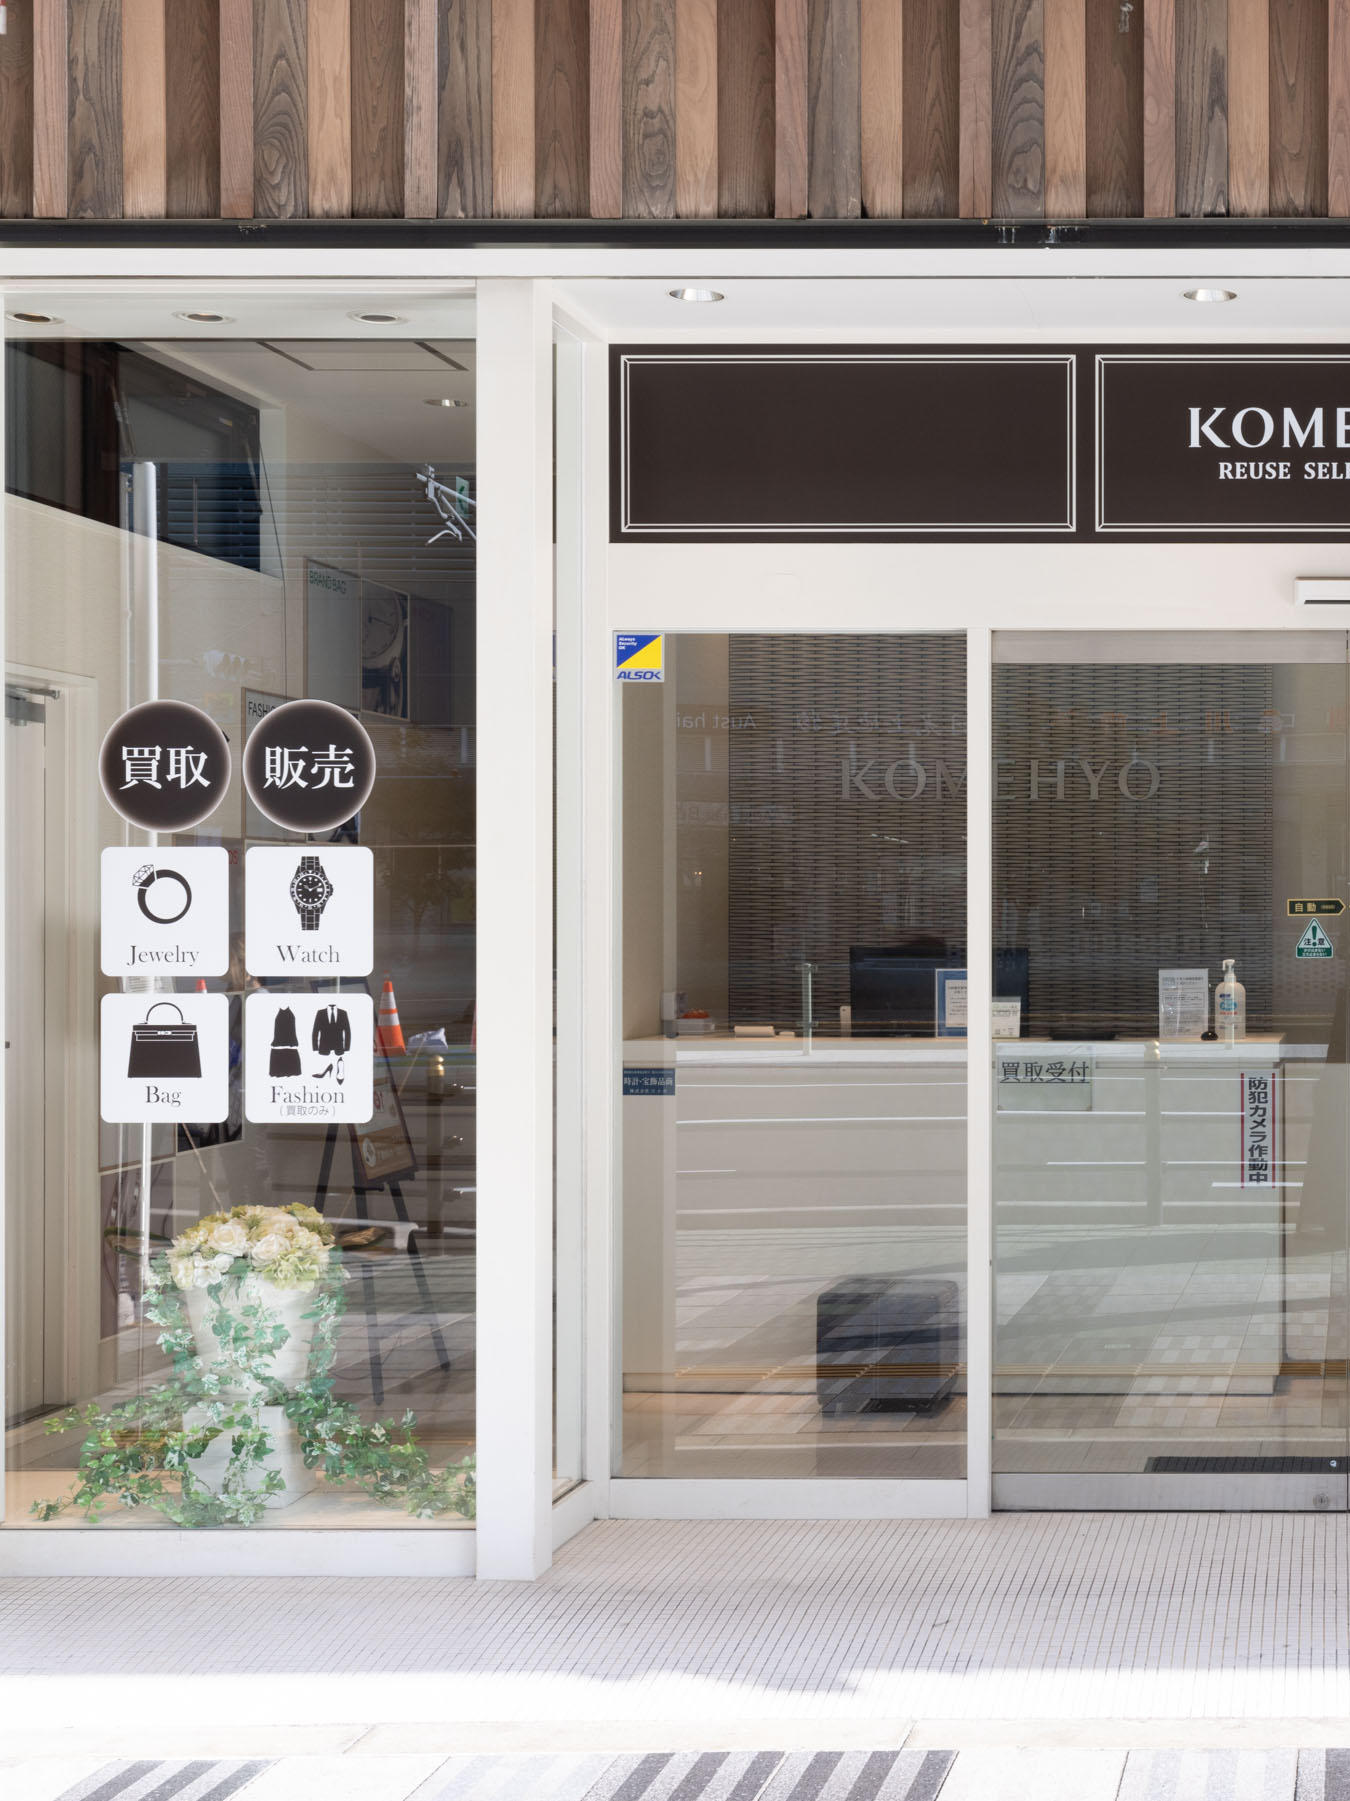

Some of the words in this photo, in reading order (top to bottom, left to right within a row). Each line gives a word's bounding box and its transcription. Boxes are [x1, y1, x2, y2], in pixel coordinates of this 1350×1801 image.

[1218, 461, 1291, 480] REUSE
[616, 671, 661, 680] ALSOK
[119, 745, 211, 790] 買取
[264, 744, 355, 789] 販売
[1295, 902, 1316, 912] 自動
[1303, 938, 1325, 946] 注意
[127, 945, 199, 967] Jewelry
[277, 945, 340, 963] Watch
[1000, 1061, 1089, 1082] 買取受付
[145, 1085, 181, 1107] Bag
[271, 1085, 344, 1103] Fashion
[1247, 1076, 1269, 1185] 防犯カメラ作動中
